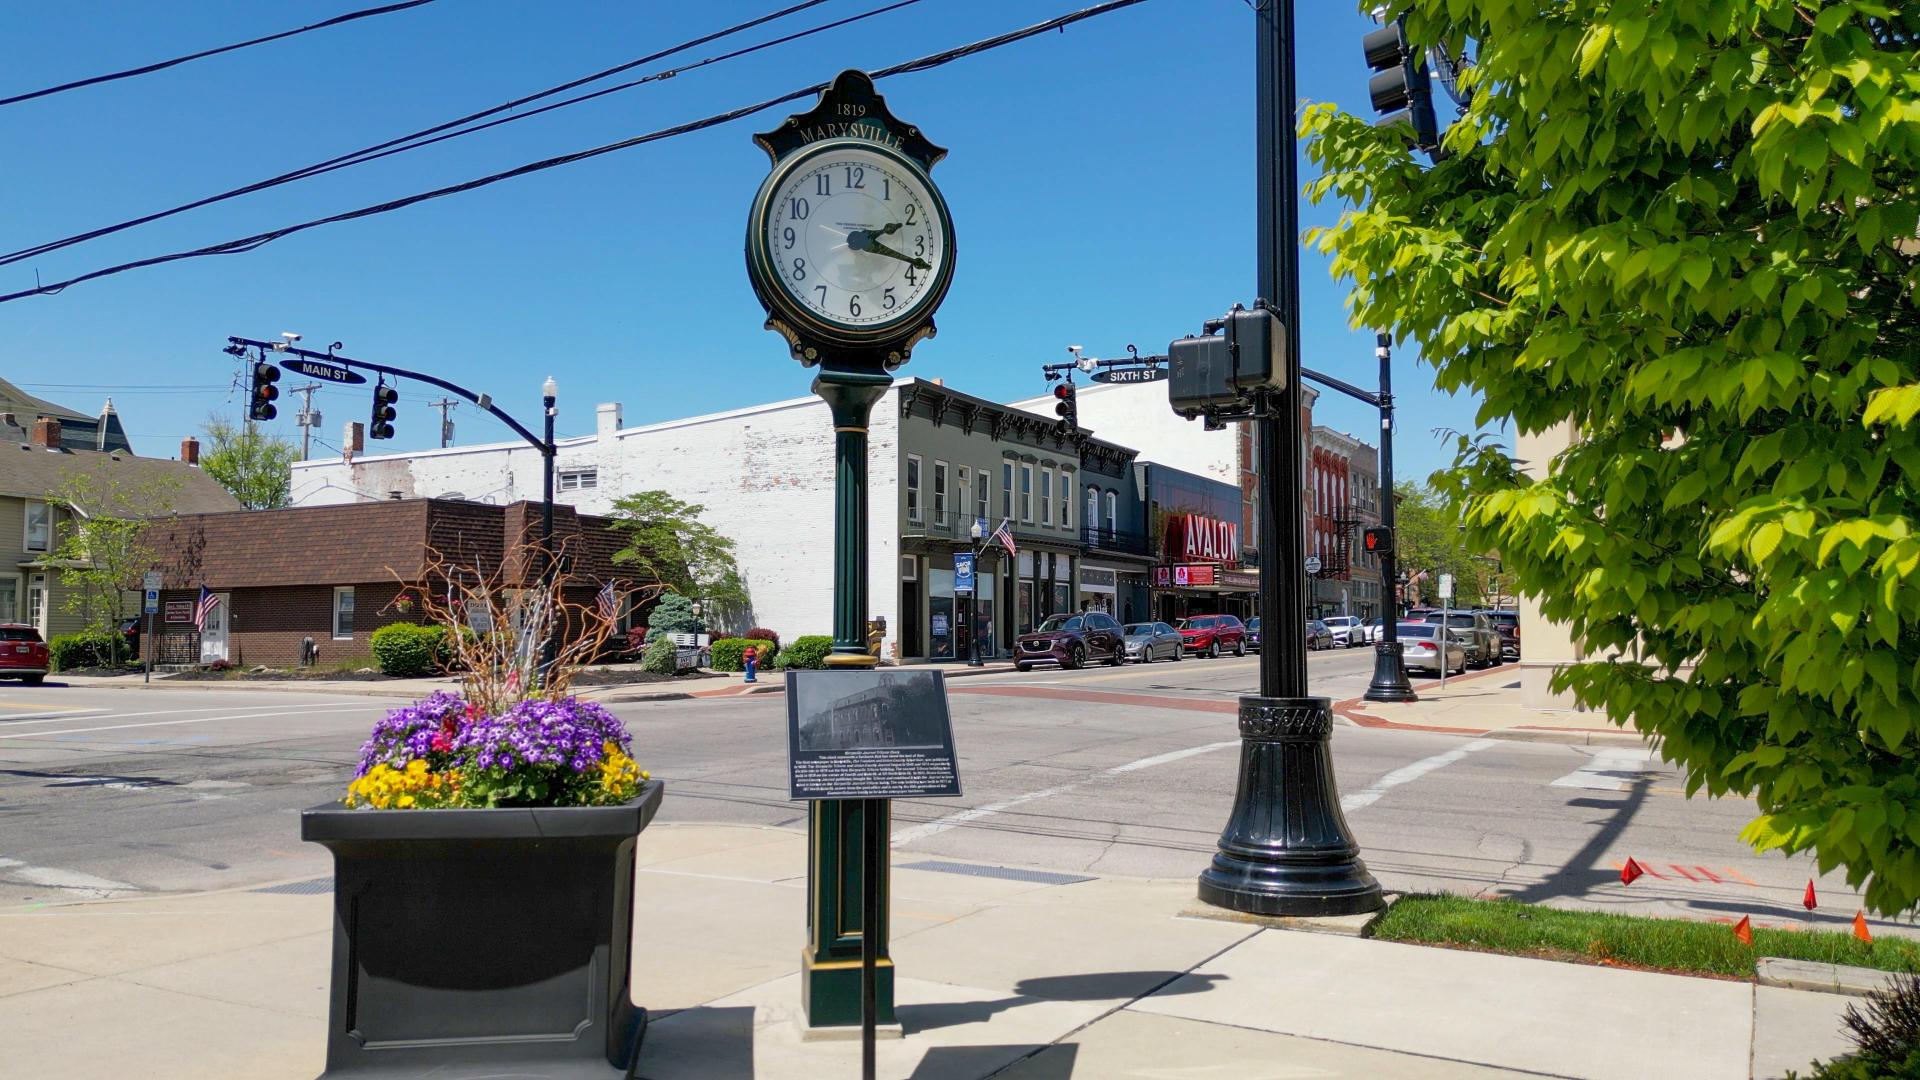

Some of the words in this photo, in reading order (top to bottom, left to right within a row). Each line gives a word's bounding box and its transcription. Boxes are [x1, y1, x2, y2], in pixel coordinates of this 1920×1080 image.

[837, 103, 866, 116] 1819
[800, 122, 905, 150] MARYSVILLE
[815, 174, 832, 196] 11
[845, 167, 865, 189] 12
[883, 179, 891, 200] 1
[790, 198, 809, 220] 10
[904, 204, 917, 226] 2
[784, 227, 796, 249] 9
[914, 235, 925, 256] 3
[793, 258, 806, 281] 8
[904, 263, 917, 286] 4
[814, 285, 827, 308] 7
[849, 295, 861, 317] 6
[882, 287, 895, 309] 5
[303, 364, 331, 377] MAIN
[334, 370, 347, 380] ST
[1110, 371, 1140, 382] SIXTH
[1143, 370, 1156, 380] ST
[1185, 513, 1238, 562] AVALON
